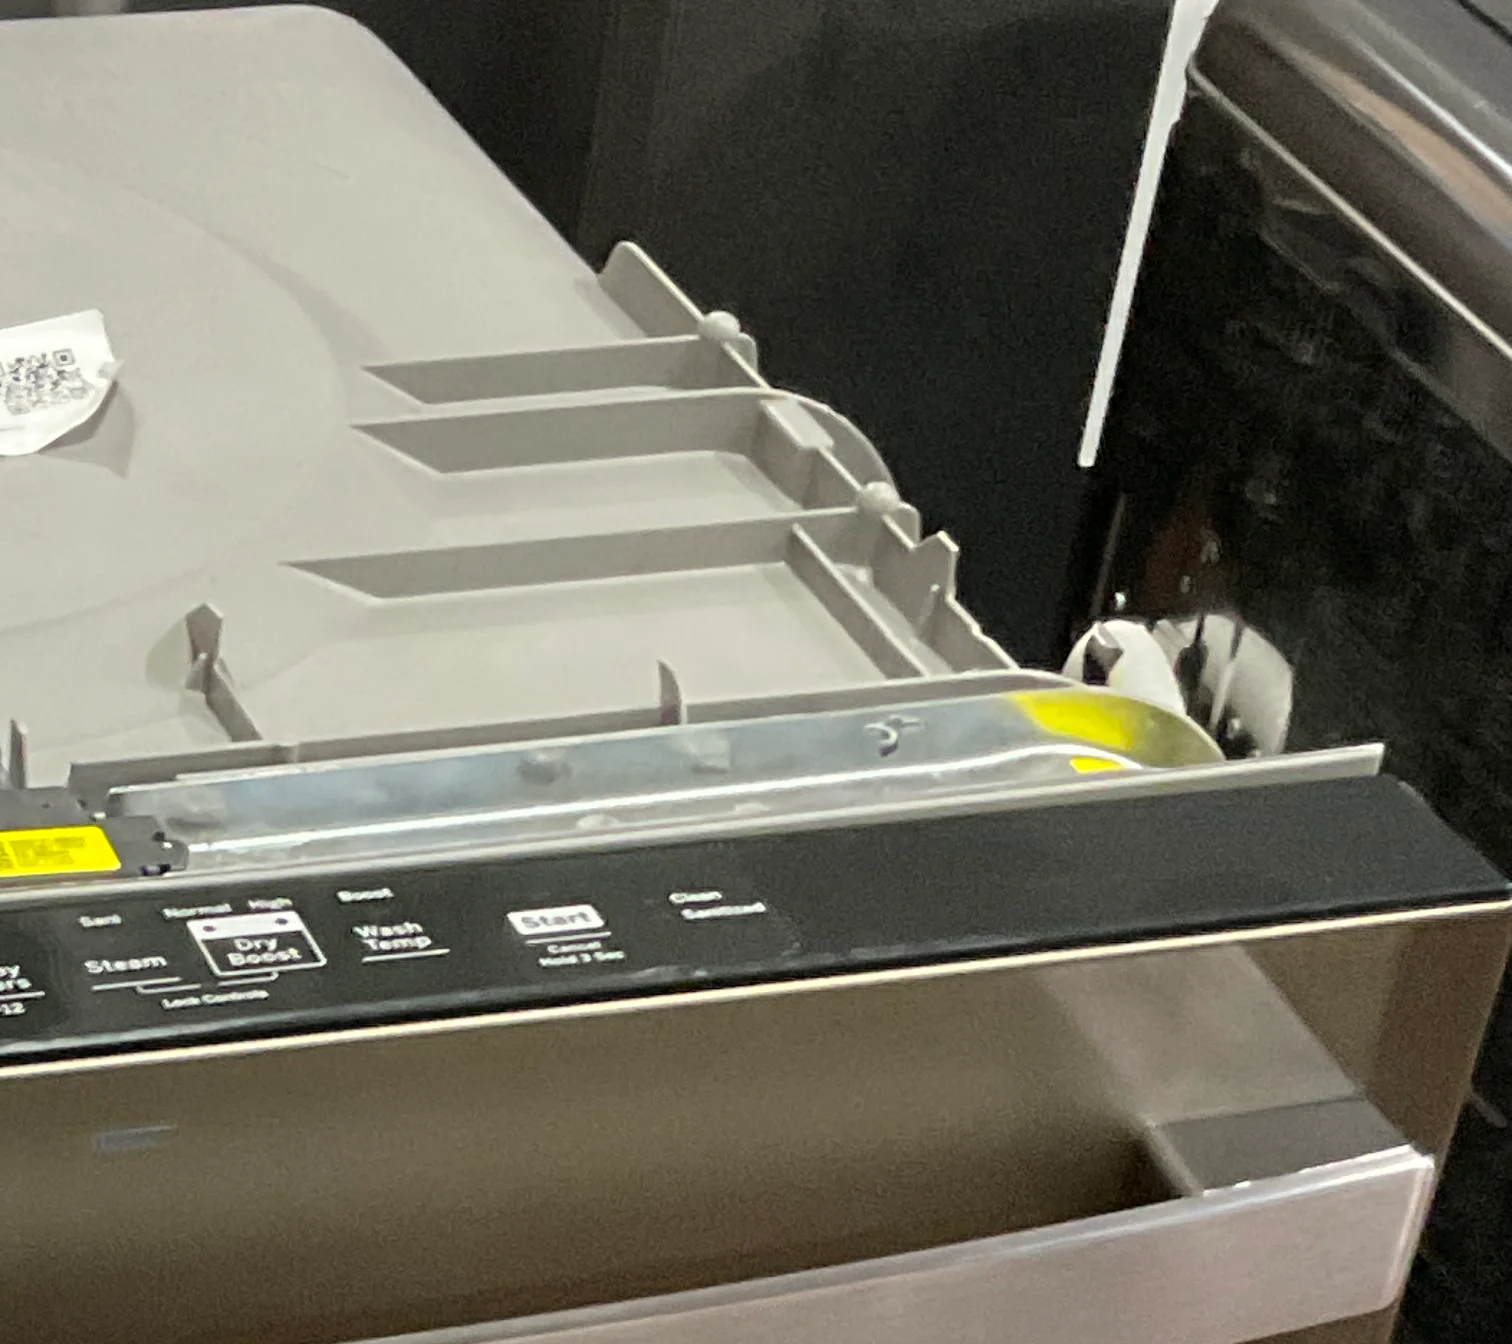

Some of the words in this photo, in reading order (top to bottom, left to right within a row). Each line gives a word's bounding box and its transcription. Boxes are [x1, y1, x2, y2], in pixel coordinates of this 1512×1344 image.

[520, 911, 592, 929] Start
[352, 921, 424, 938] Wash
[233, 938, 278, 951] Dry
[361, 935, 432, 951] Temp
[84, 955, 168, 975] Steam
[226, 947, 303, 967] Boost
